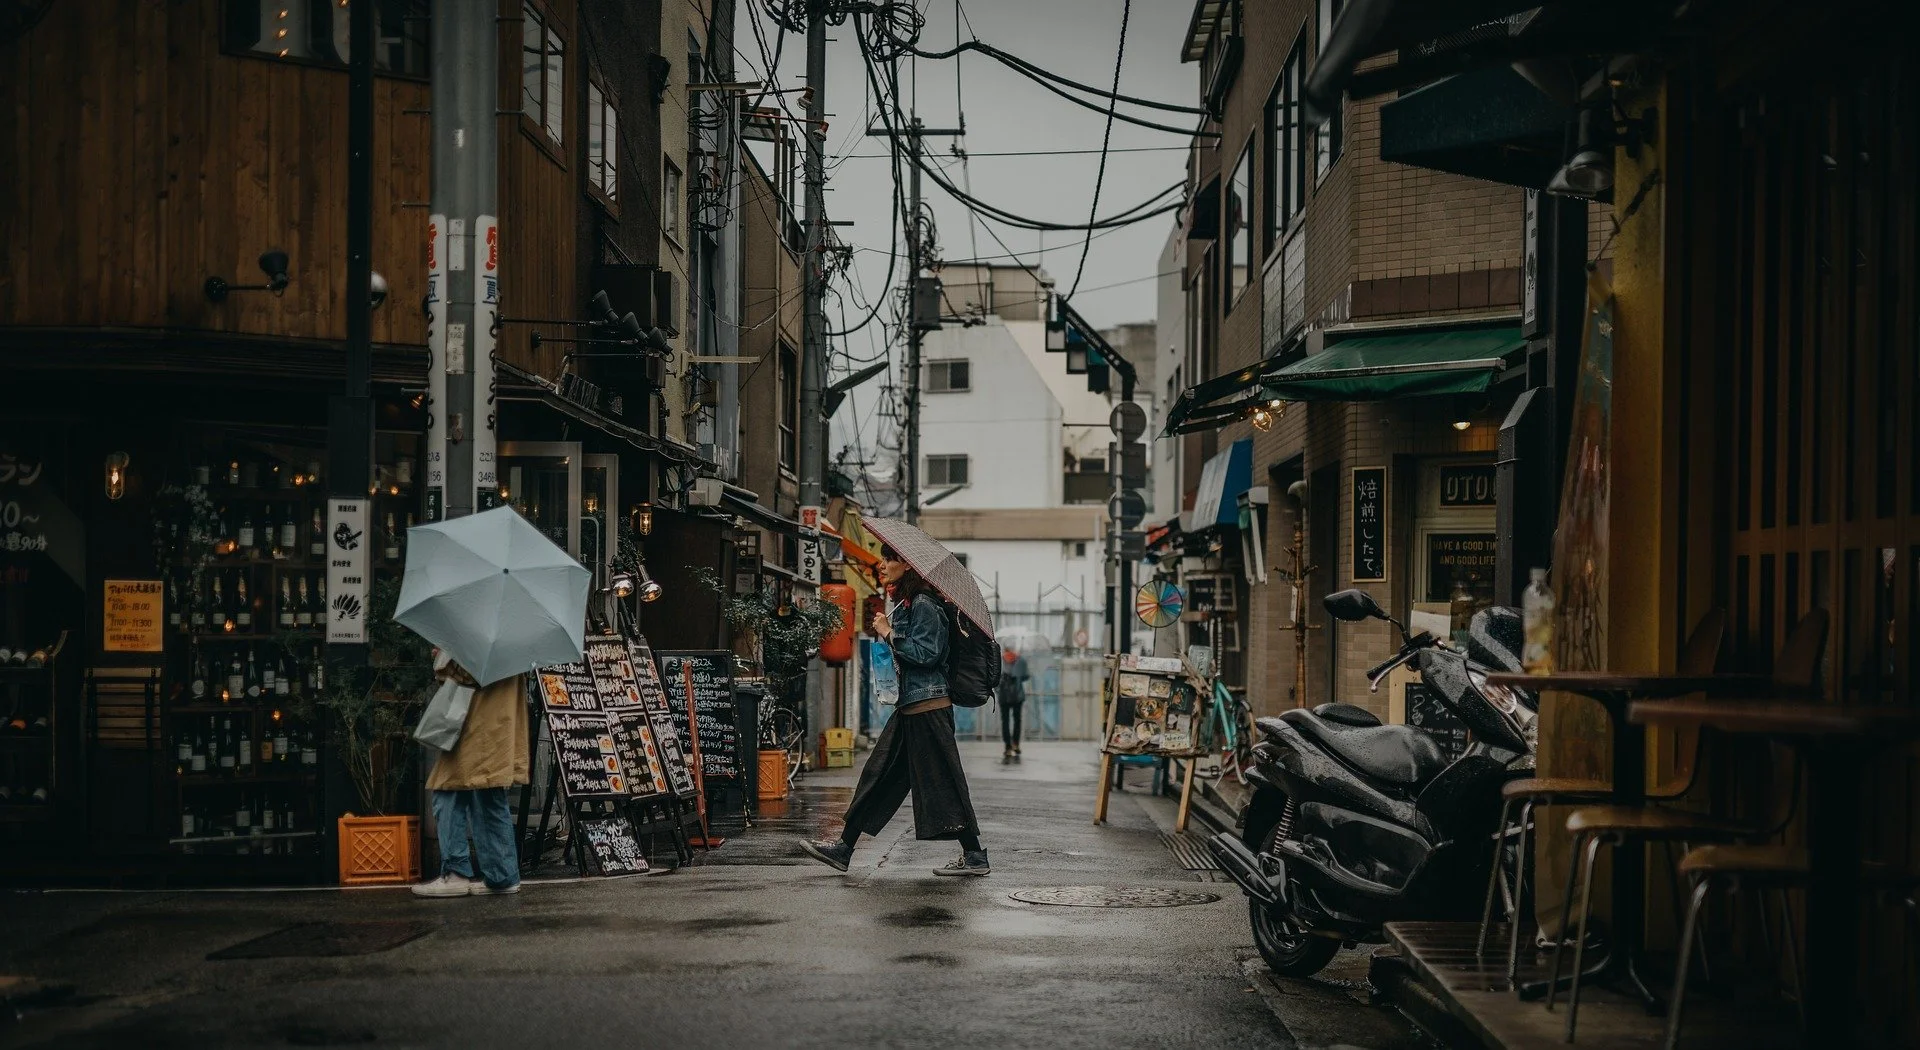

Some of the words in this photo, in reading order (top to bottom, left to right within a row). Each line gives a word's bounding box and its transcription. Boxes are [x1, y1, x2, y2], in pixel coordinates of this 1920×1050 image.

[1434, 541, 1453, 551] HAVE
[1456, 541, 1462, 551] A
[1463, 541, 1483, 551] GOOD
[1440, 555, 1455, 565] AND
[1457, 555, 1478, 565] GOOD
[1479, 555, 1496, 565] LIFE
